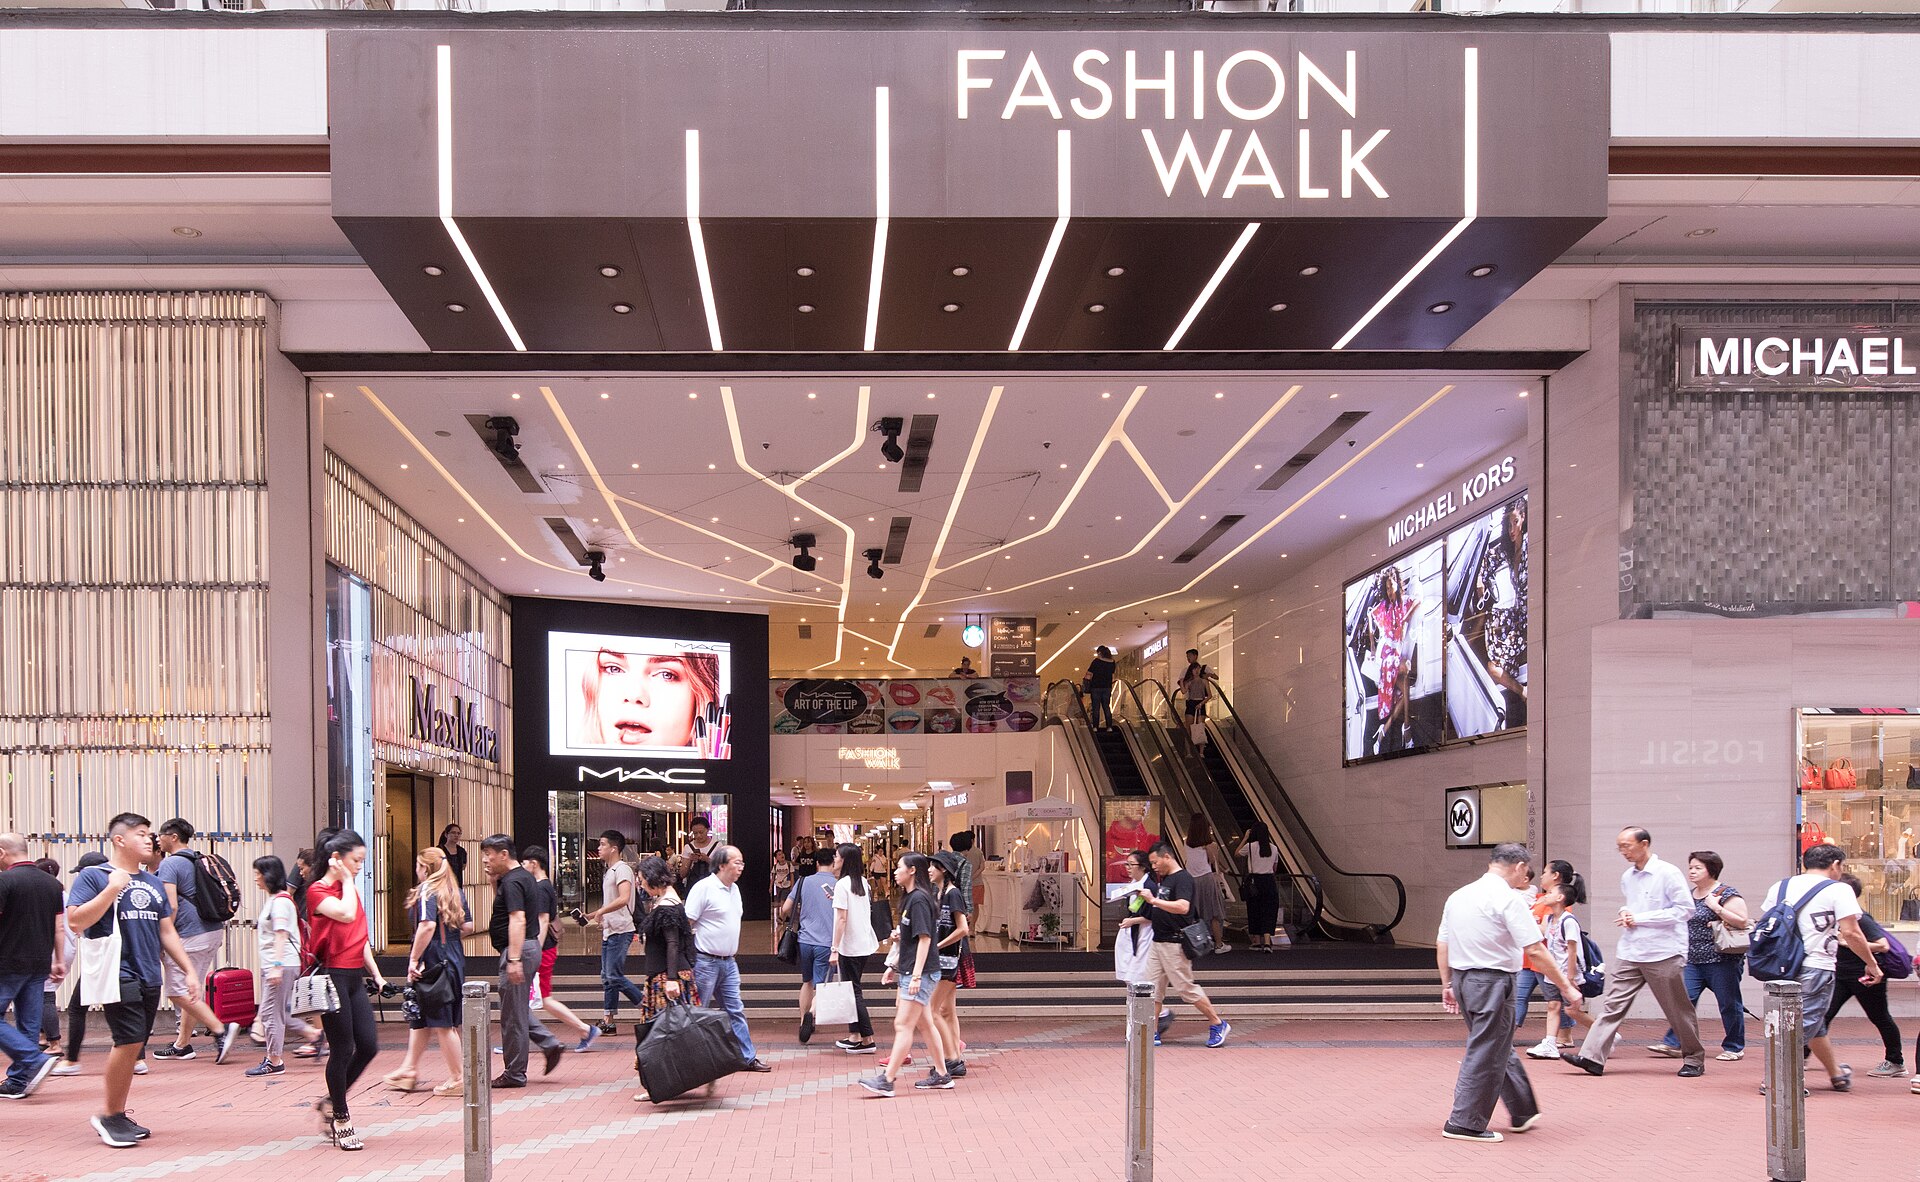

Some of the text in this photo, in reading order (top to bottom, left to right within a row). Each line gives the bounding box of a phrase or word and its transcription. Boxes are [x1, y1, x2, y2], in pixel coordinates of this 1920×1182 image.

[957, 49, 1357, 120] FASHION
[1141, 128, 1391, 199] WALK
[1700, 337, 1917, 376] MICHAEL
[1388, 456, 1516, 548] MICHAEL KORS
[794, 699, 858, 710] ART OF THE LIP
[838, 747, 897, 760] FASHION
[864, 758, 901, 769] WALK
[120, 910, 138, 920] AND
